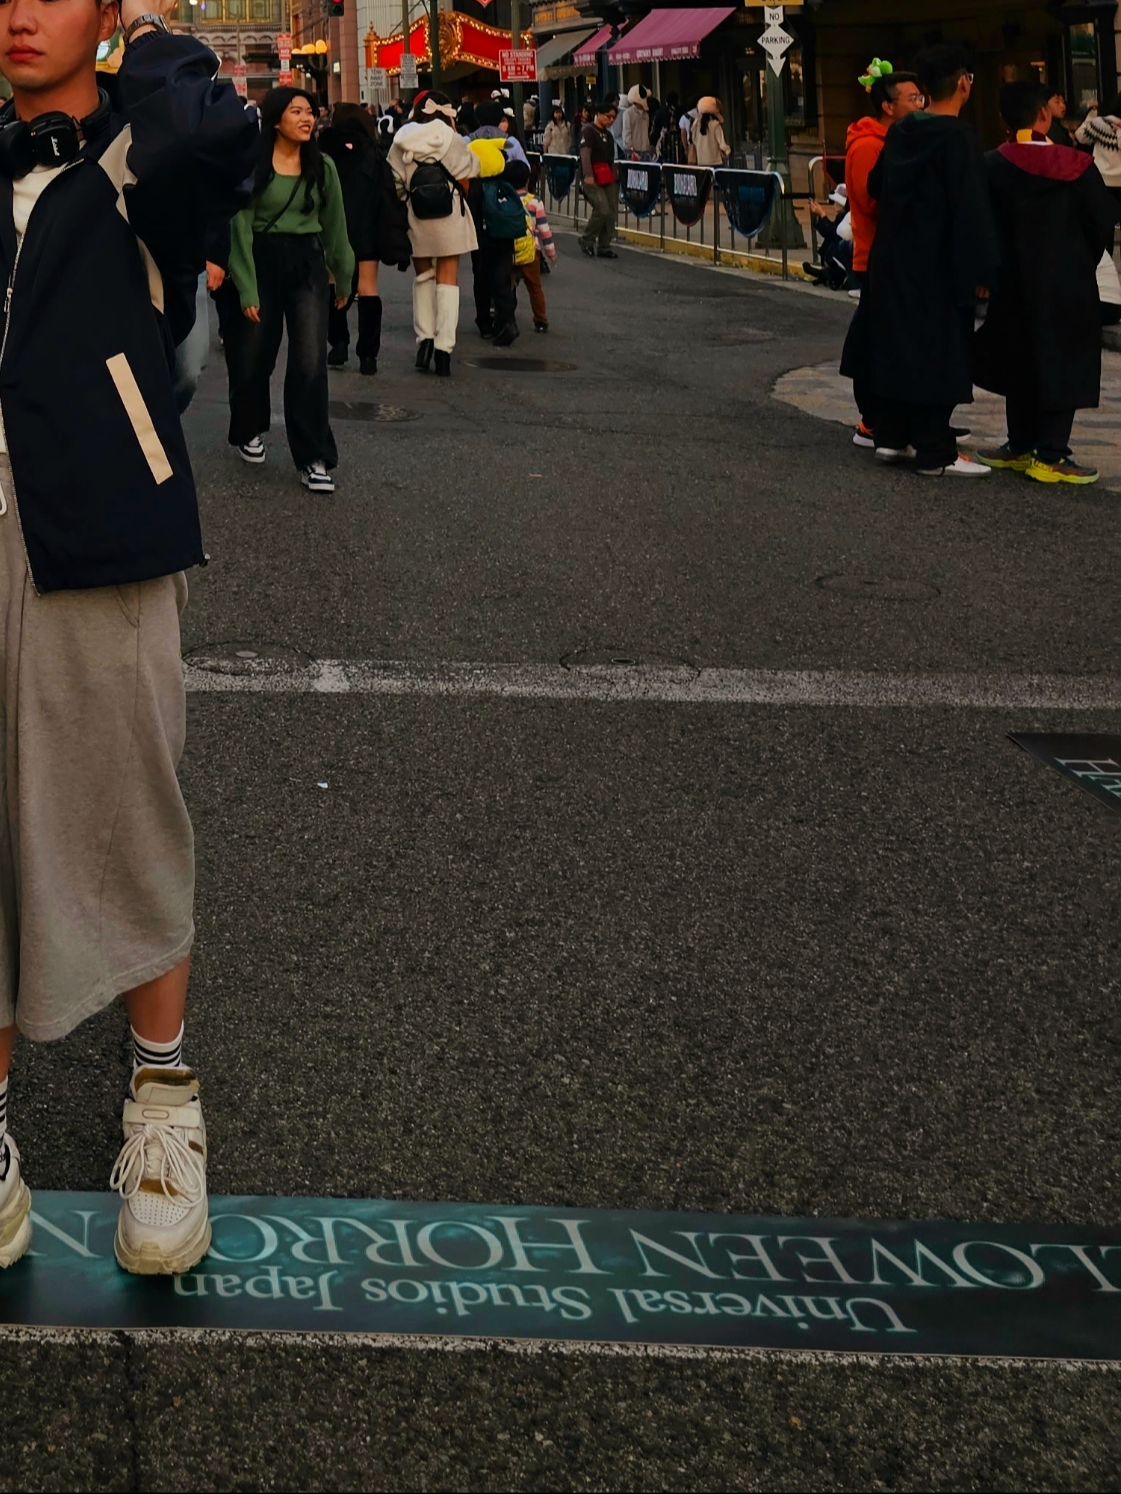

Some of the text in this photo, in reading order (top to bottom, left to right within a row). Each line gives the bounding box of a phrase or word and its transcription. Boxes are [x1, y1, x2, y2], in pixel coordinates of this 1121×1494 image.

[761, 36, 790, 44] PARKING
[209, 1213, 614, 1275] HORRO
[628, 1226, 1121, 1293] LOWEEN
[173, 1266, 918, 1333] Universal Studios Japan
